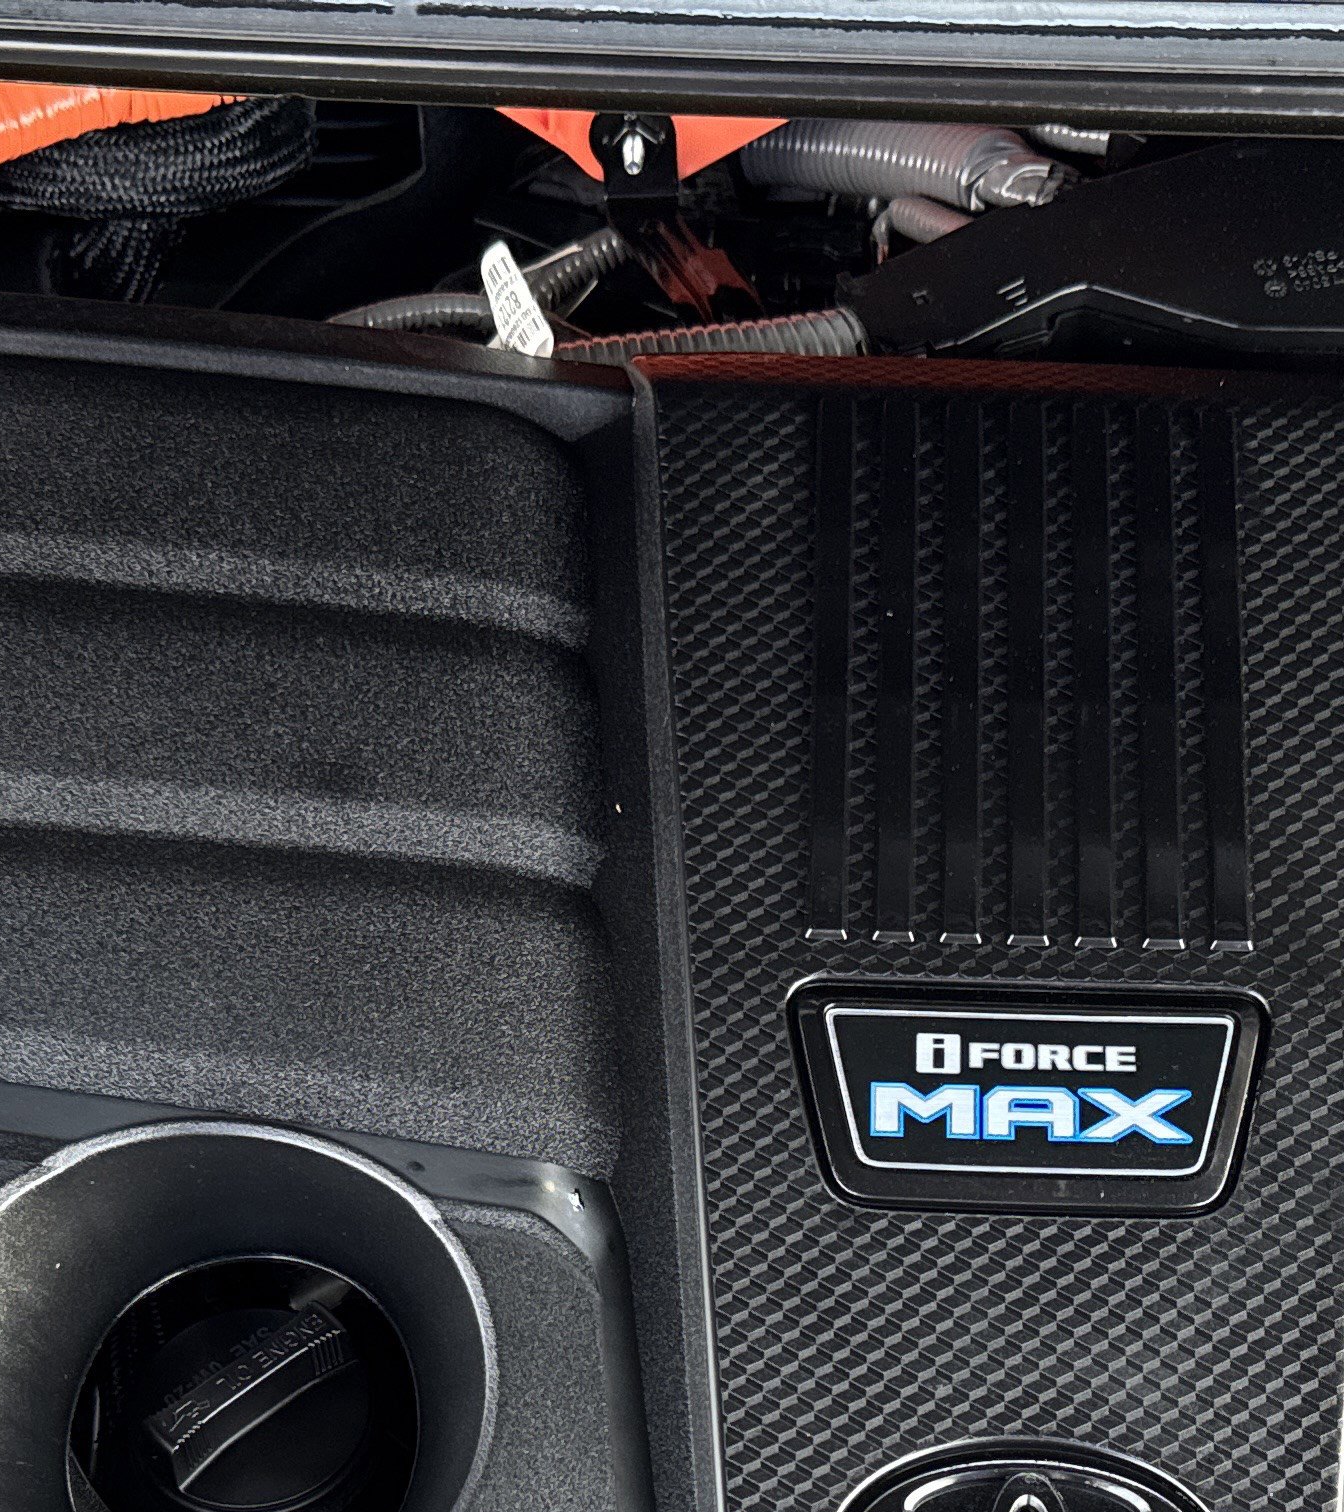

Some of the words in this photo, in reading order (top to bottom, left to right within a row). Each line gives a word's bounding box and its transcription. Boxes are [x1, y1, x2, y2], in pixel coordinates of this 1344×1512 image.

[968, 1041, 1138, 1073] FORCE
[869, 1081, 1194, 1145] MAX
[250, 1313, 327, 1369] ENGINE
[215, 1363, 253, 1391] OIL
